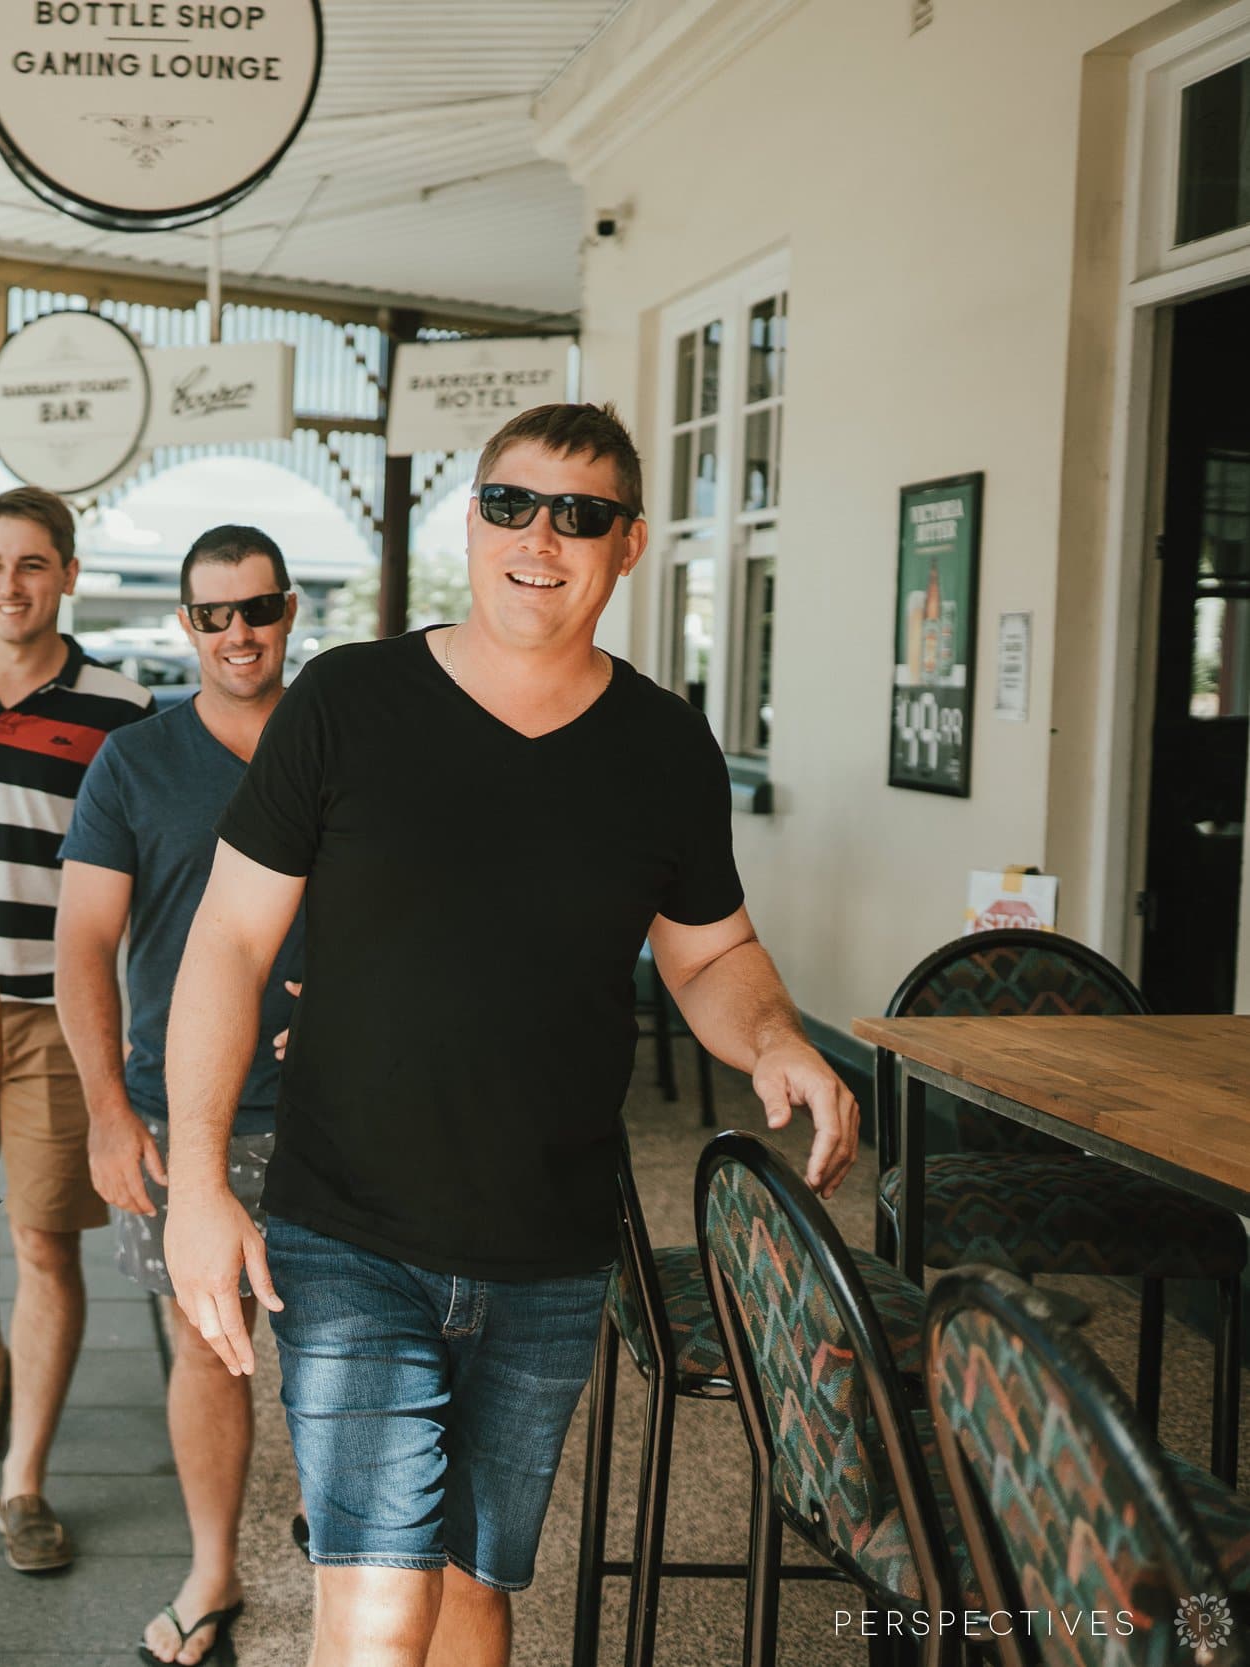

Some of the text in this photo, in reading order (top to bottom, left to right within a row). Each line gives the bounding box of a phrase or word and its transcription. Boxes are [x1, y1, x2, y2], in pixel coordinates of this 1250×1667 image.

[35, 2, 265, 30] BOTTLE SHOP
[13, 51, 281, 81] GAMING LOUNGE
[409, 368, 554, 391] BARRIER REEF
[436, 388, 517, 409] HOTEL
[39, 400, 93, 424] BAR
